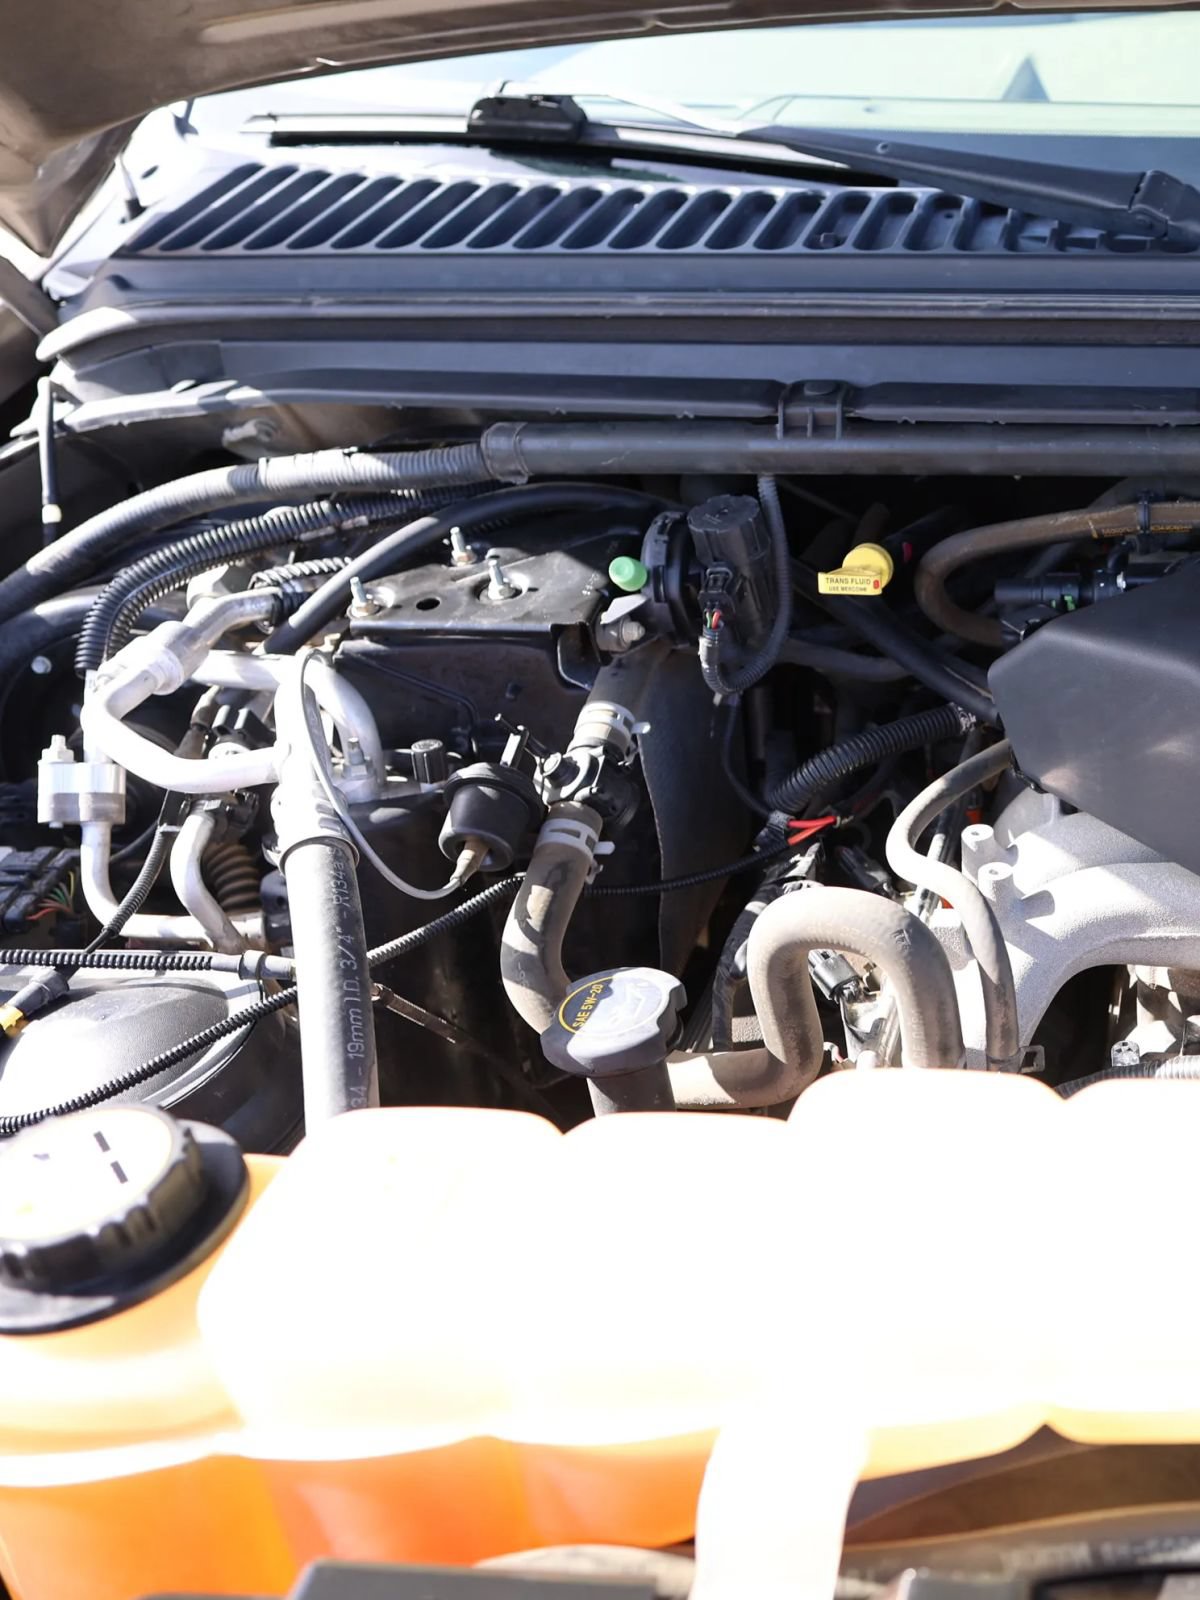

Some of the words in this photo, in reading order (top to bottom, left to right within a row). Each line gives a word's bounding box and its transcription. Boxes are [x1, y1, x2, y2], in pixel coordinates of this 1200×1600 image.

[825, 577, 849, 585] TRANS
[850, 577, 871, 585] FLUID
[331, 862, 351, 908] R134a
[580, 984, 604, 1010] 5W-20
[572, 1011, 591, 1027] SAE
[346, 1007, 365, 1060] 19mm
